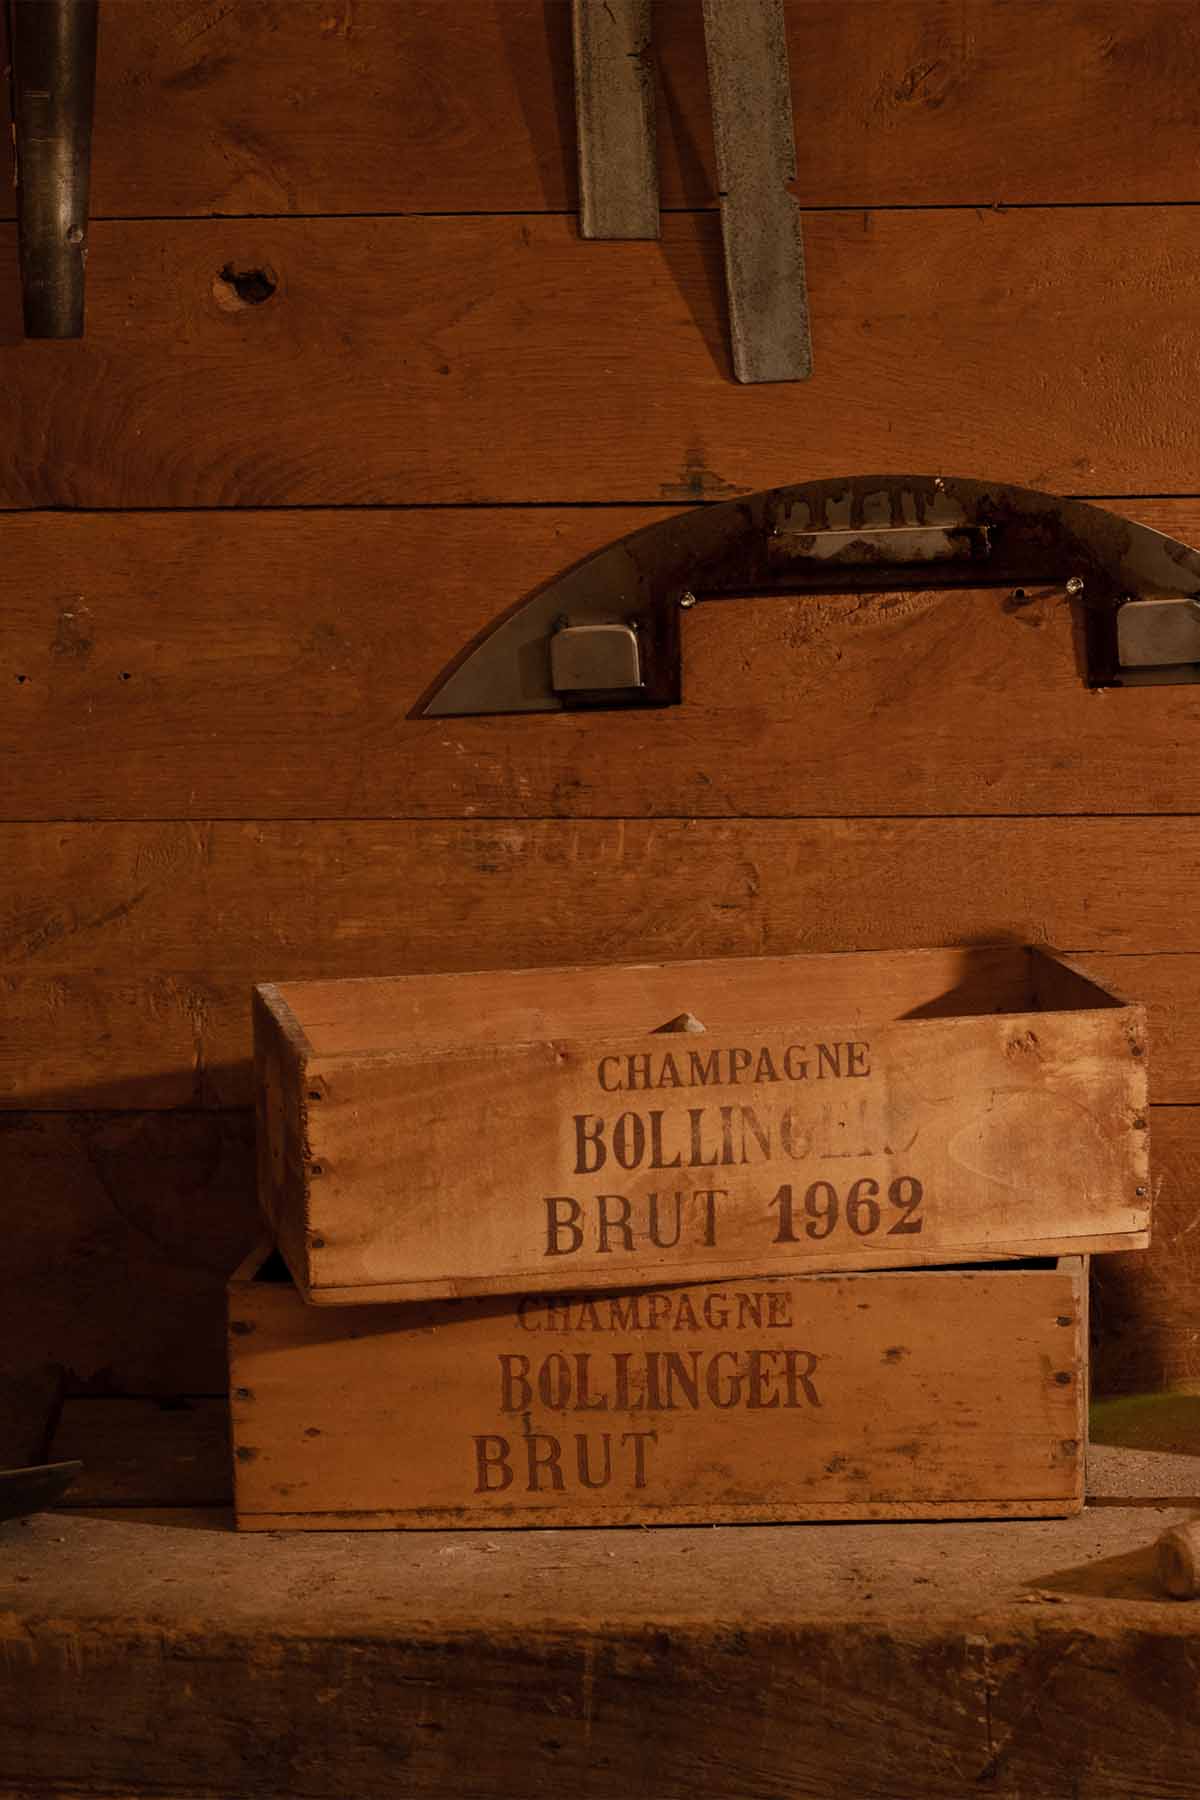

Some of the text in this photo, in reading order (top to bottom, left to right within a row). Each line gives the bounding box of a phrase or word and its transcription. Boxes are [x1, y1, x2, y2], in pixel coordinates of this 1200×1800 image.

[598, 1041, 871, 1093] CHAMPAGNE
[573, 1101, 919, 1174] BOLLING
[544, 1176, 924, 1257] BRUT 1962
[516, 1291, 793, 1331] CHAMPAGNE
[499, 1349, 822, 1412] BOLLINGER
[472, 1432, 658, 1494] BRUT
